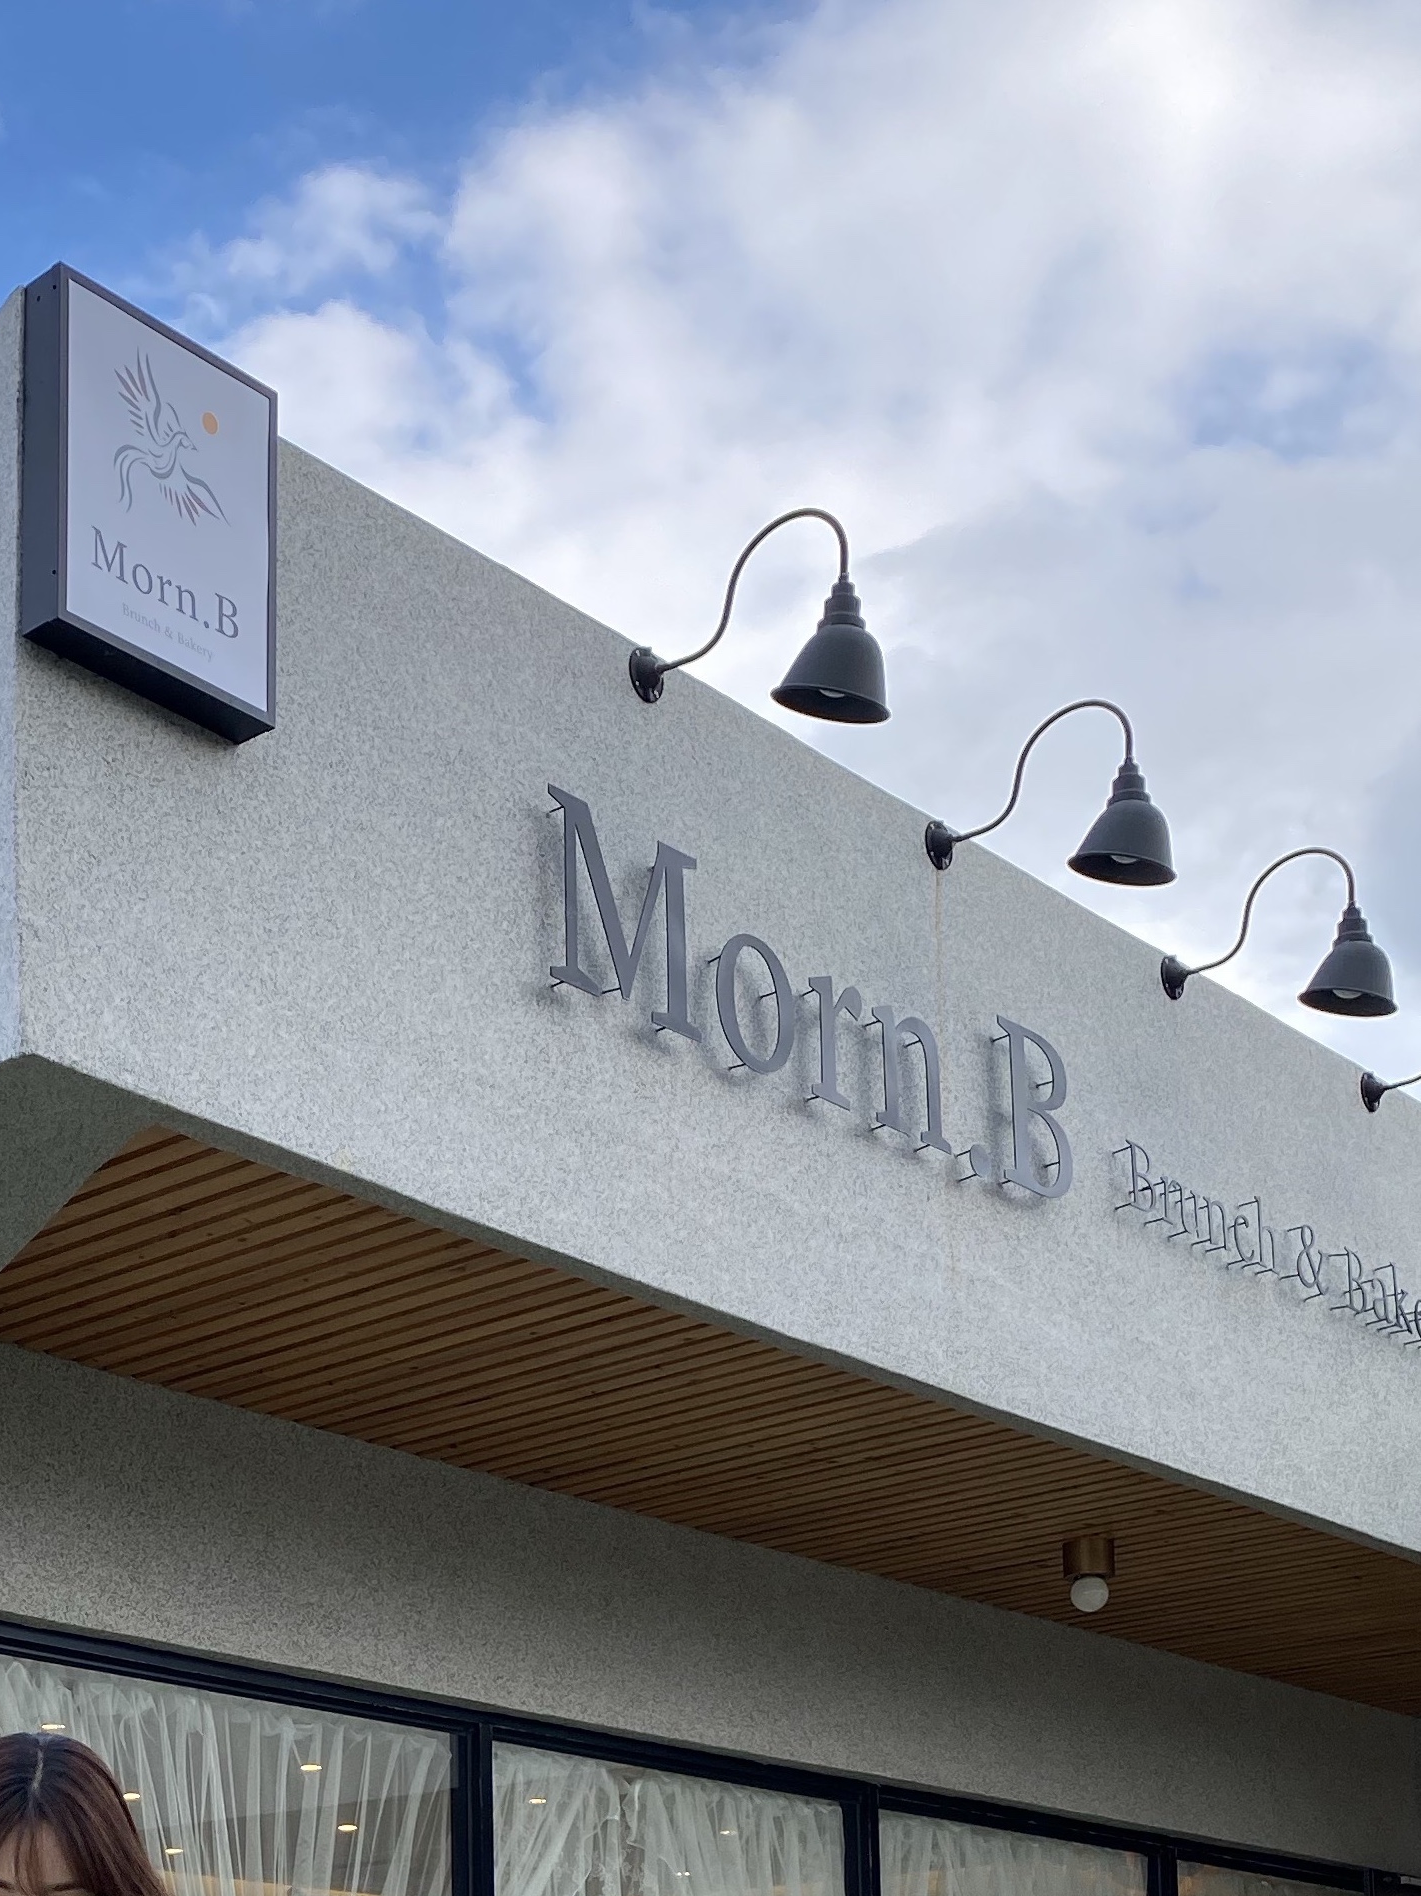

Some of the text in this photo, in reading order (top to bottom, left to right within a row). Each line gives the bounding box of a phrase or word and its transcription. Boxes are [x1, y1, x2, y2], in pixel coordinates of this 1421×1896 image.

[91, 525, 239, 639] Morn.B
[122, 602, 213, 662] Brunch & Bakery
[547, 783, 1074, 1199] Morn.B
[1125, 1139, 1279, 1275] Brunch
[1296, 1224, 1329, 1297] &
